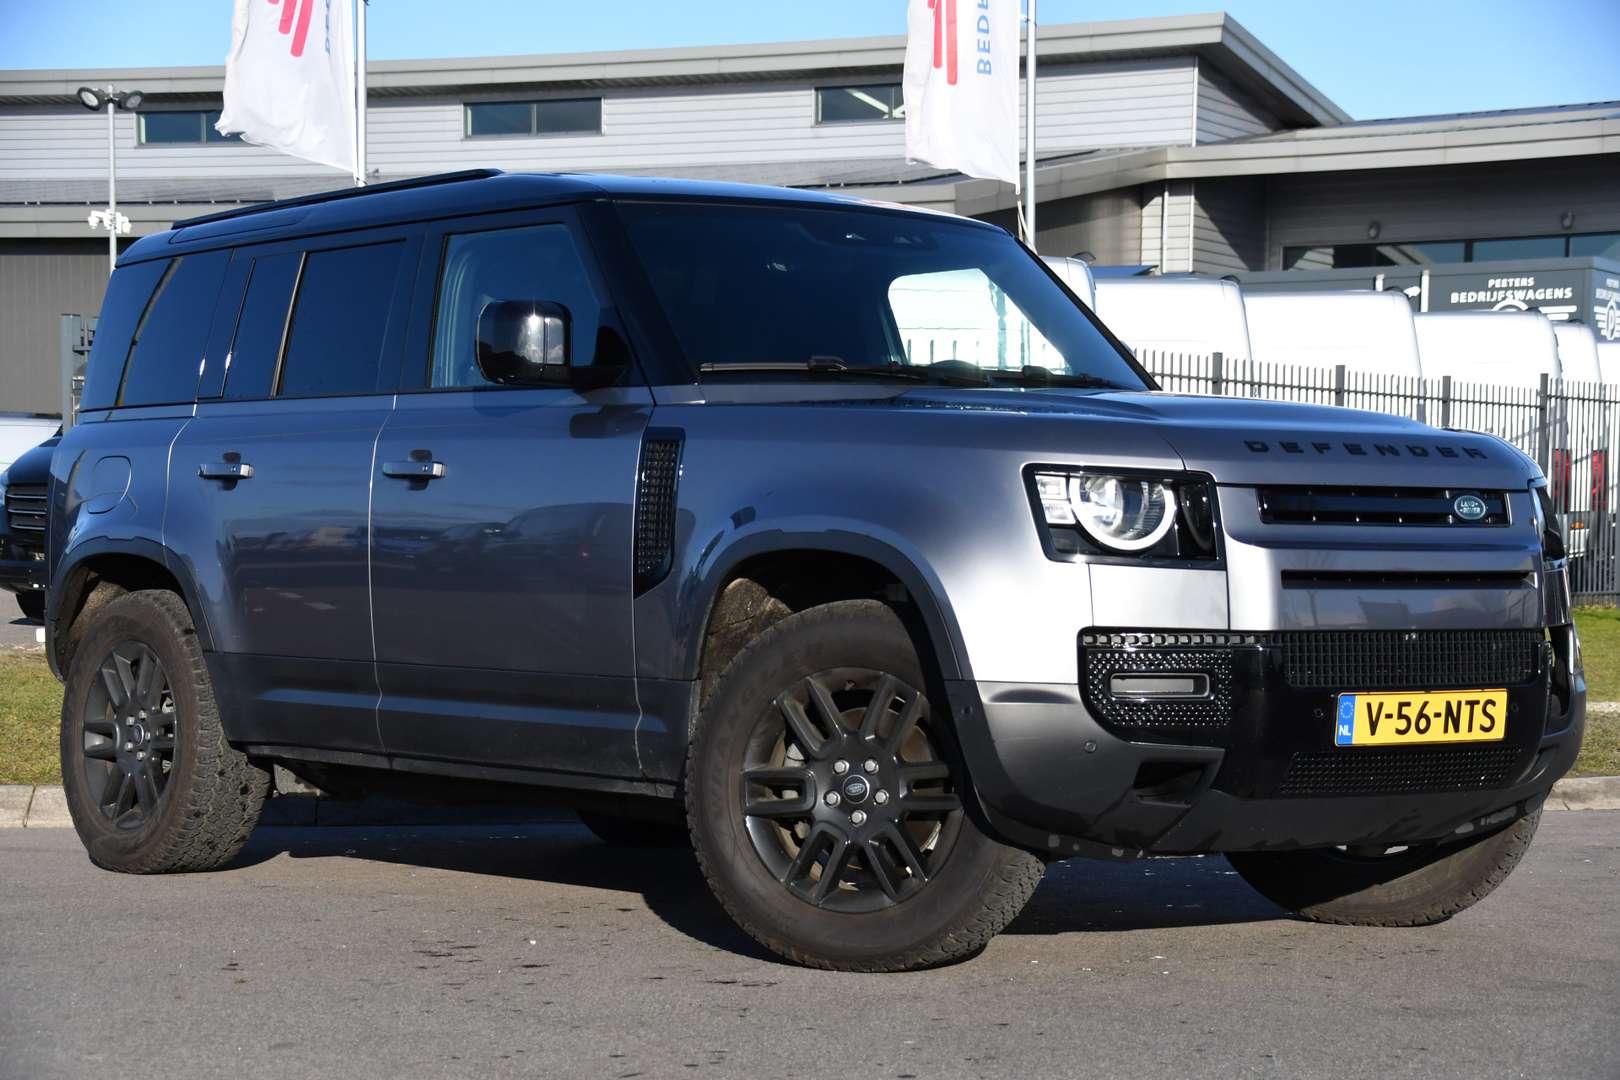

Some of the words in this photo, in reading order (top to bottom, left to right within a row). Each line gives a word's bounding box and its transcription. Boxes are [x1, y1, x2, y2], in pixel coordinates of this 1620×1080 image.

[1488, 277, 1535, 288] PEETERS
[1450, 287, 1573, 303] BEDRIJFSWAGENS
[1243, 440, 1488, 459] DEFENDER
[1366, 699, 1497, 736] V-56-NTS
[1338, 725, 1351, 736] NL
